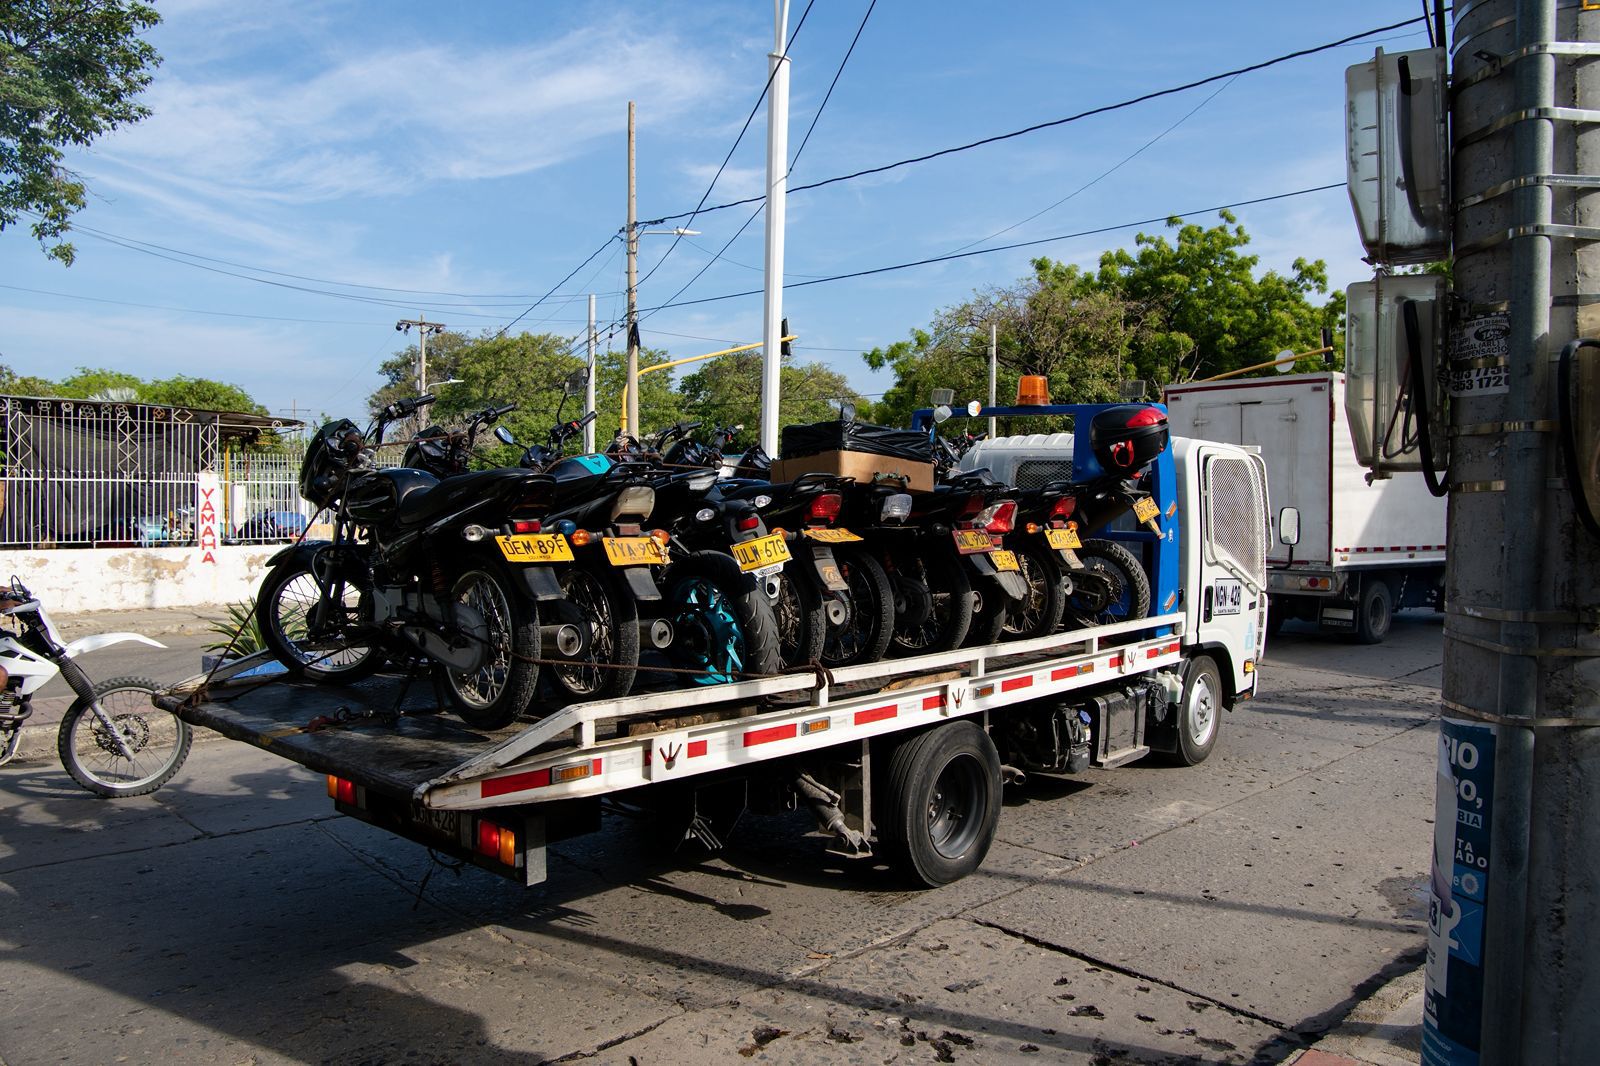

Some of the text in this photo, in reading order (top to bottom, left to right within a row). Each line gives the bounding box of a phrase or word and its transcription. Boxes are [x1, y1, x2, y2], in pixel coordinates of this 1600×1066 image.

[201, 488, 216, 564] YAMAHA
[502, 539, 565, 555] DEM 89F
[638, 542, 660, 556] 90
[764, 538, 786, 558] 67G
[1214, 585, 1241, 607] NGN 428
[1455, 850, 1488, 868] ADO
